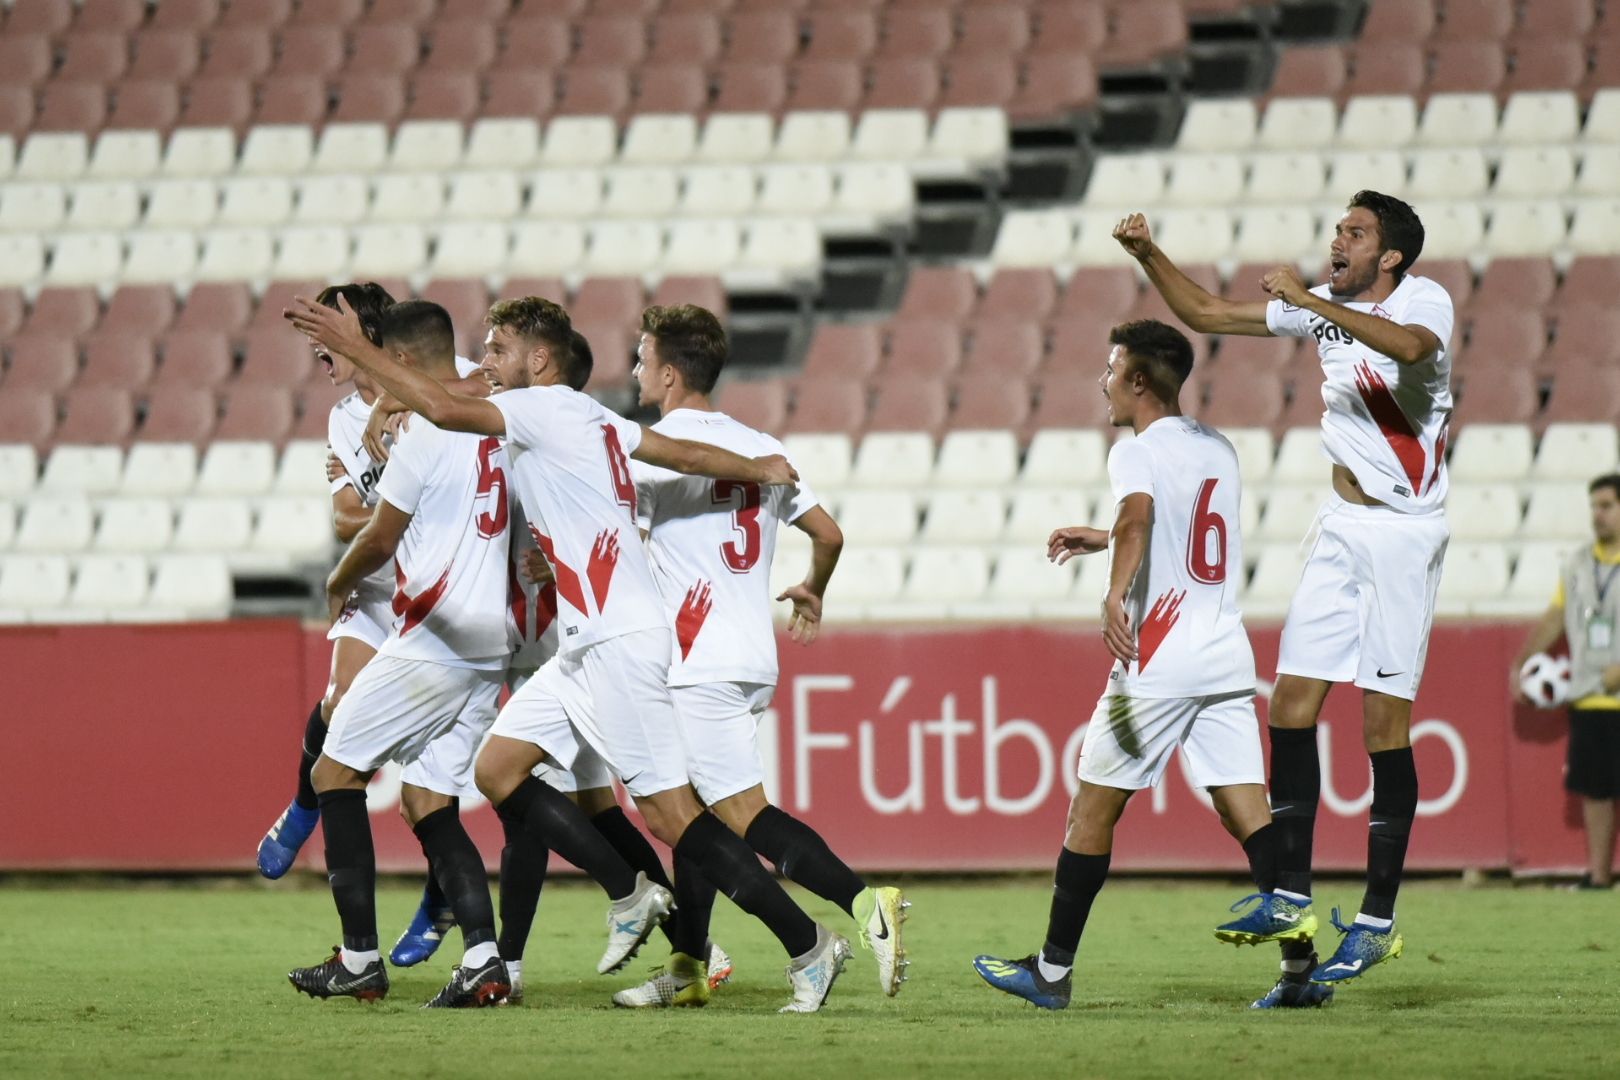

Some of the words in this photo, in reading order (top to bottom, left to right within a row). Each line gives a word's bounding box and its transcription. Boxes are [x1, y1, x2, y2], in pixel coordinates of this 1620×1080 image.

[475, 436, 509, 541] 5
[601, 423, 638, 525] 4
[711, 479, 761, 575] 3
[1186, 478, 1227, 585] 6
